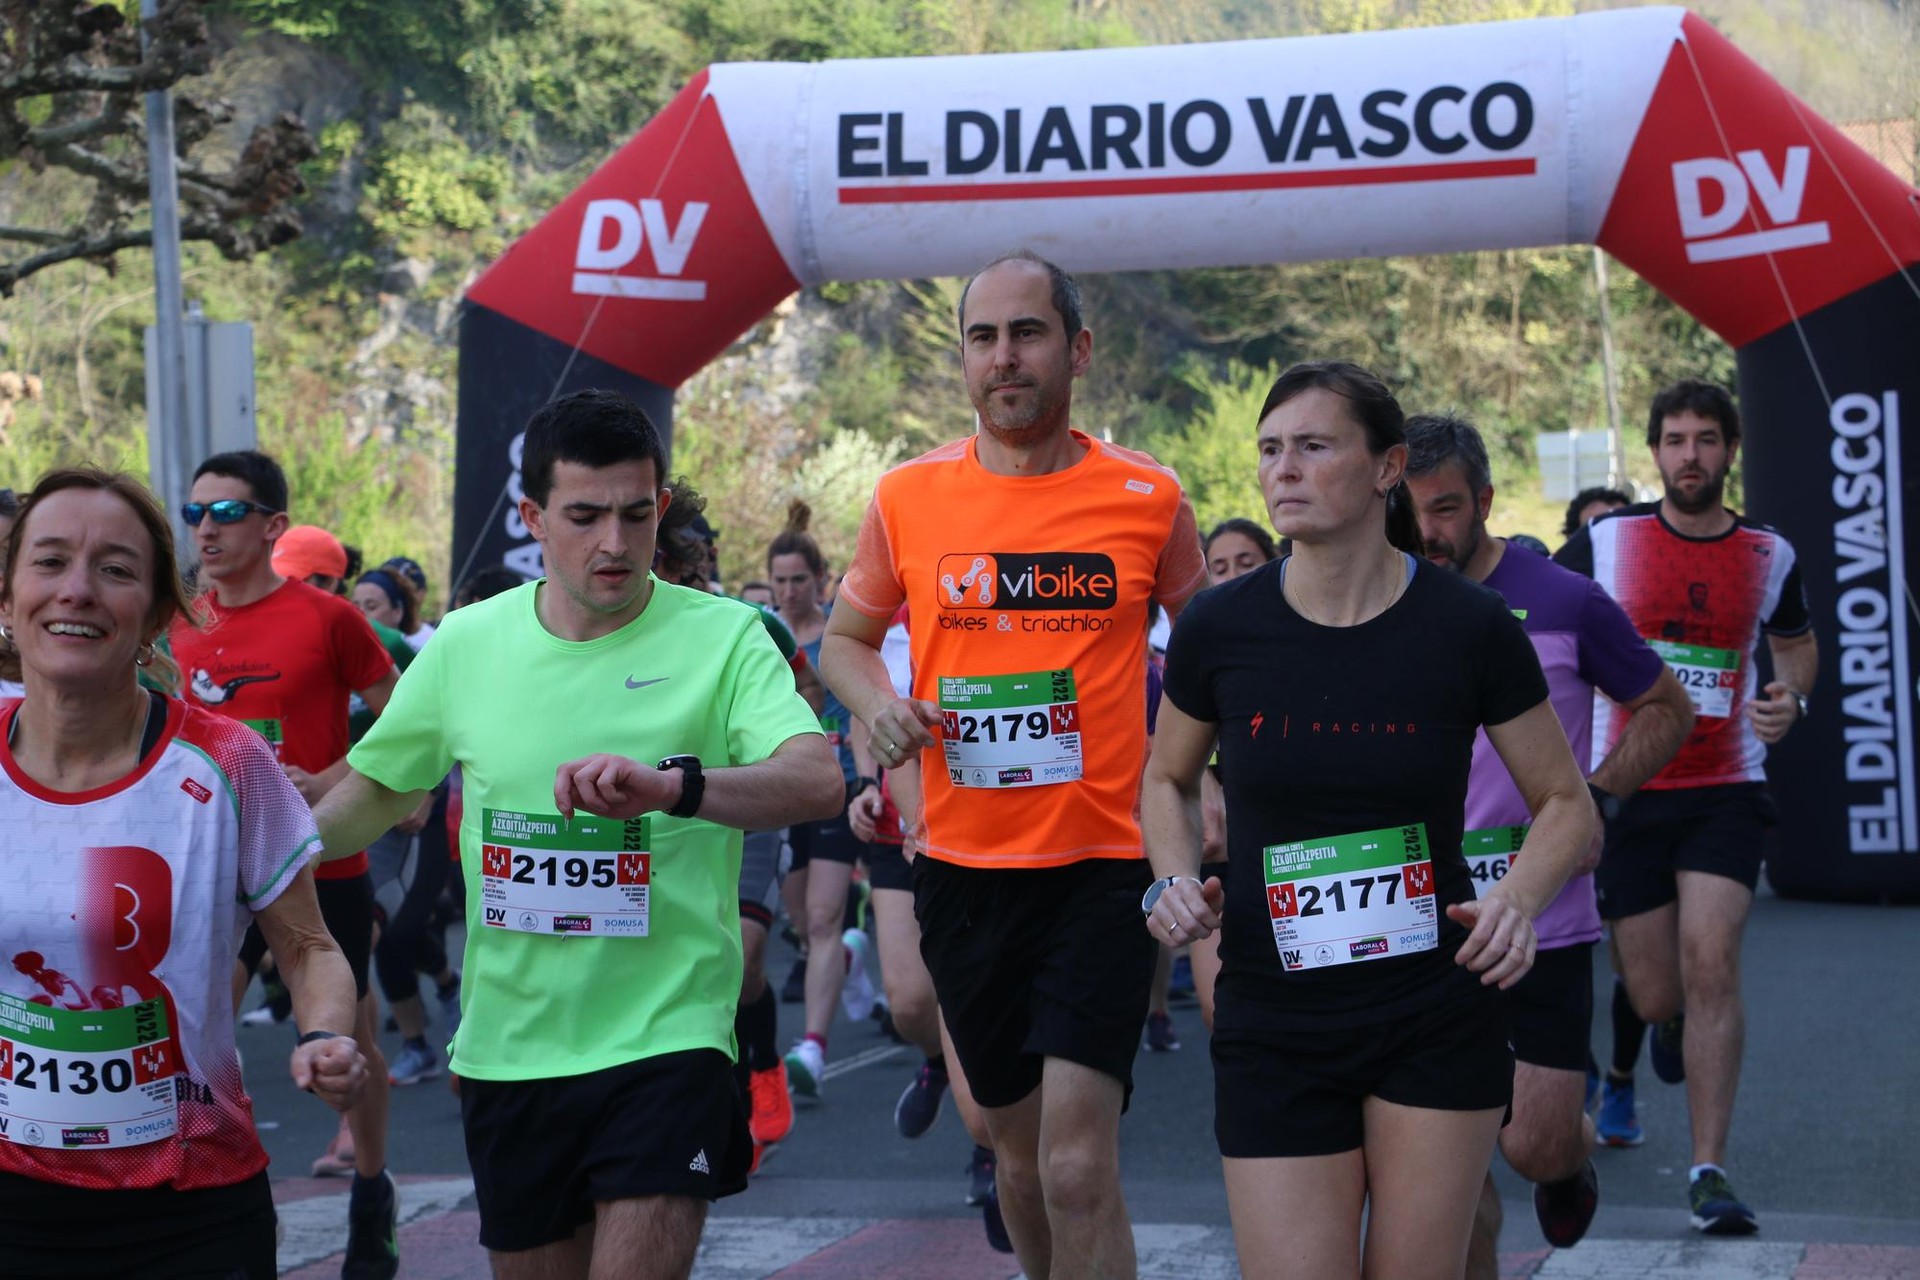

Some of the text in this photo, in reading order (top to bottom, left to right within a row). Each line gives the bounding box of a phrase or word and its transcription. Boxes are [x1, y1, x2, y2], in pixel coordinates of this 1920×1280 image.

[838, 81, 1535, 178] EL DIARIO VASCO
[1671, 145, 1811, 239] DV
[575, 198, 710, 276] DV
[1001, 564, 1113, 598] vibike
[938, 613, 1113, 632] bikes & triathlon
[1829, 393, 1900, 853] EL DIARIO VASCO
[1052, 671, 1070, 702] 2022
[1671, 668, 1718, 689] 023
[960, 711, 1049, 743] 2179
[1313, 722, 1417, 733] RACING
[950, 769, 963, 780] DV
[1044, 765, 1078, 776] DOMUSA
[492, 818, 557, 835] AZKOITIAZPEITIA
[624, 818, 642, 851] 2022
[1272, 846, 1337, 867] AZKOITIAZPEITIA
[1403, 827, 1422, 862] 2022
[512, 855, 616, 888] 2195
[1298, 873, 1402, 918] 2177
[487, 908, 506, 922] DV
[604, 919, 643, 927] DOMUSA
[1352, 942, 1379, 951] LABORAL
[1400, 931, 1435, 945] DOMUSA
[1283, 949, 1300, 964] DV
[0, 1003, 55, 1032] ZKOITIAZPEITIA
[134, 1001, 159, 1044] 2022
[14, 1051, 132, 1095] 2130
[125, 1118, 174, 1137] DOMUSA
